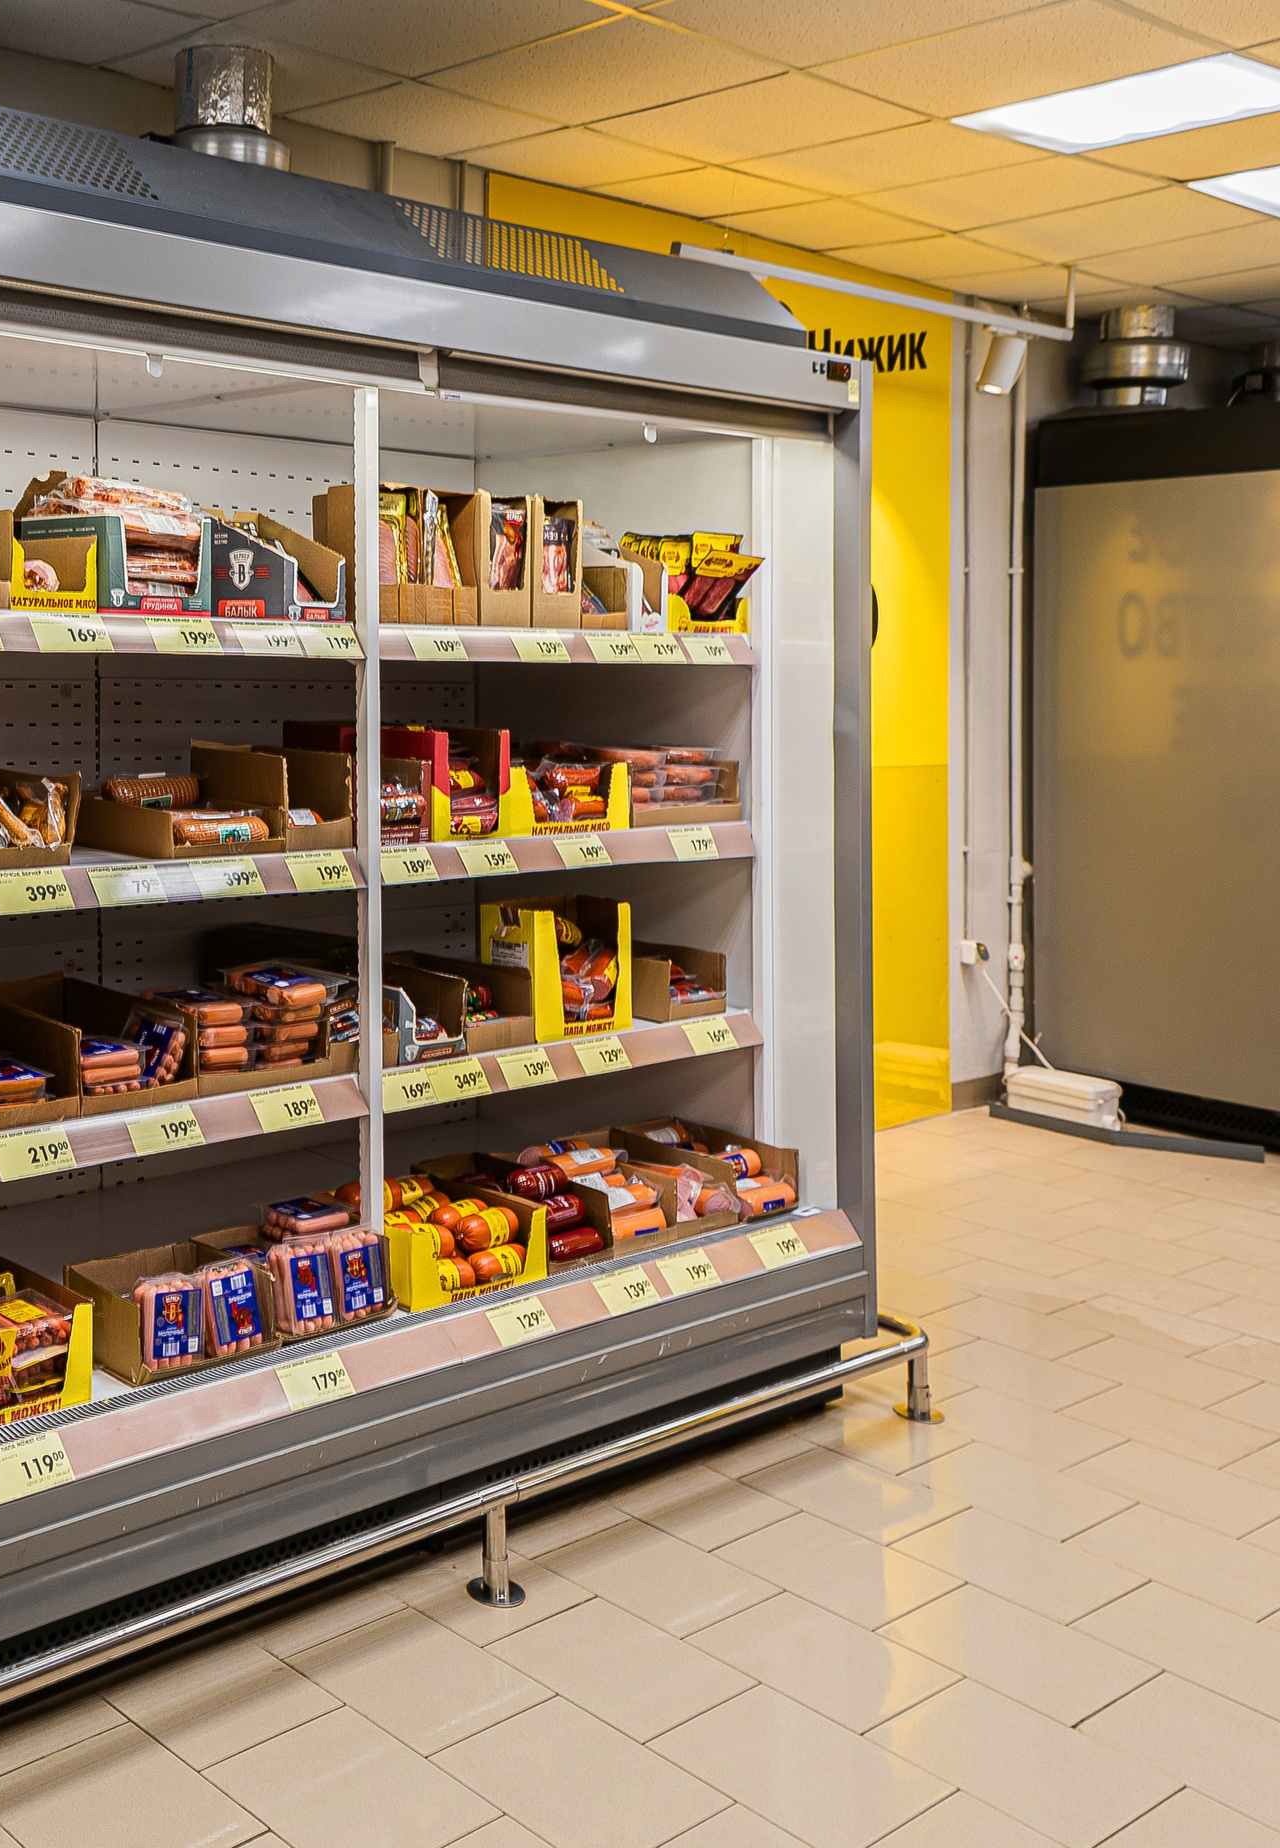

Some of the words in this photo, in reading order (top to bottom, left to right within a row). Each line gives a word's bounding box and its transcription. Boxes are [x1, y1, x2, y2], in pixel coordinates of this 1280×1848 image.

[11, 597, 74, 609] НАТУРАЛЬНОЕ
[76, 599, 96, 609] МЯСО
[143, 601, 178, 611] ГРУДИНКА
[224, 605, 258, 618] БАЛЫК
[531, 824, 590, 836] НАТУРАЛЬНОЕ
[590, 821, 610, 832] МЯСО
[564, 1025, 584, 1036] ПАПА
[586, 1021, 615, 1034] МОЖЕТ!
[451, 1291, 475, 1302] ПАПА
[10, 1397, 62, 1424] МОЖЕТ!
